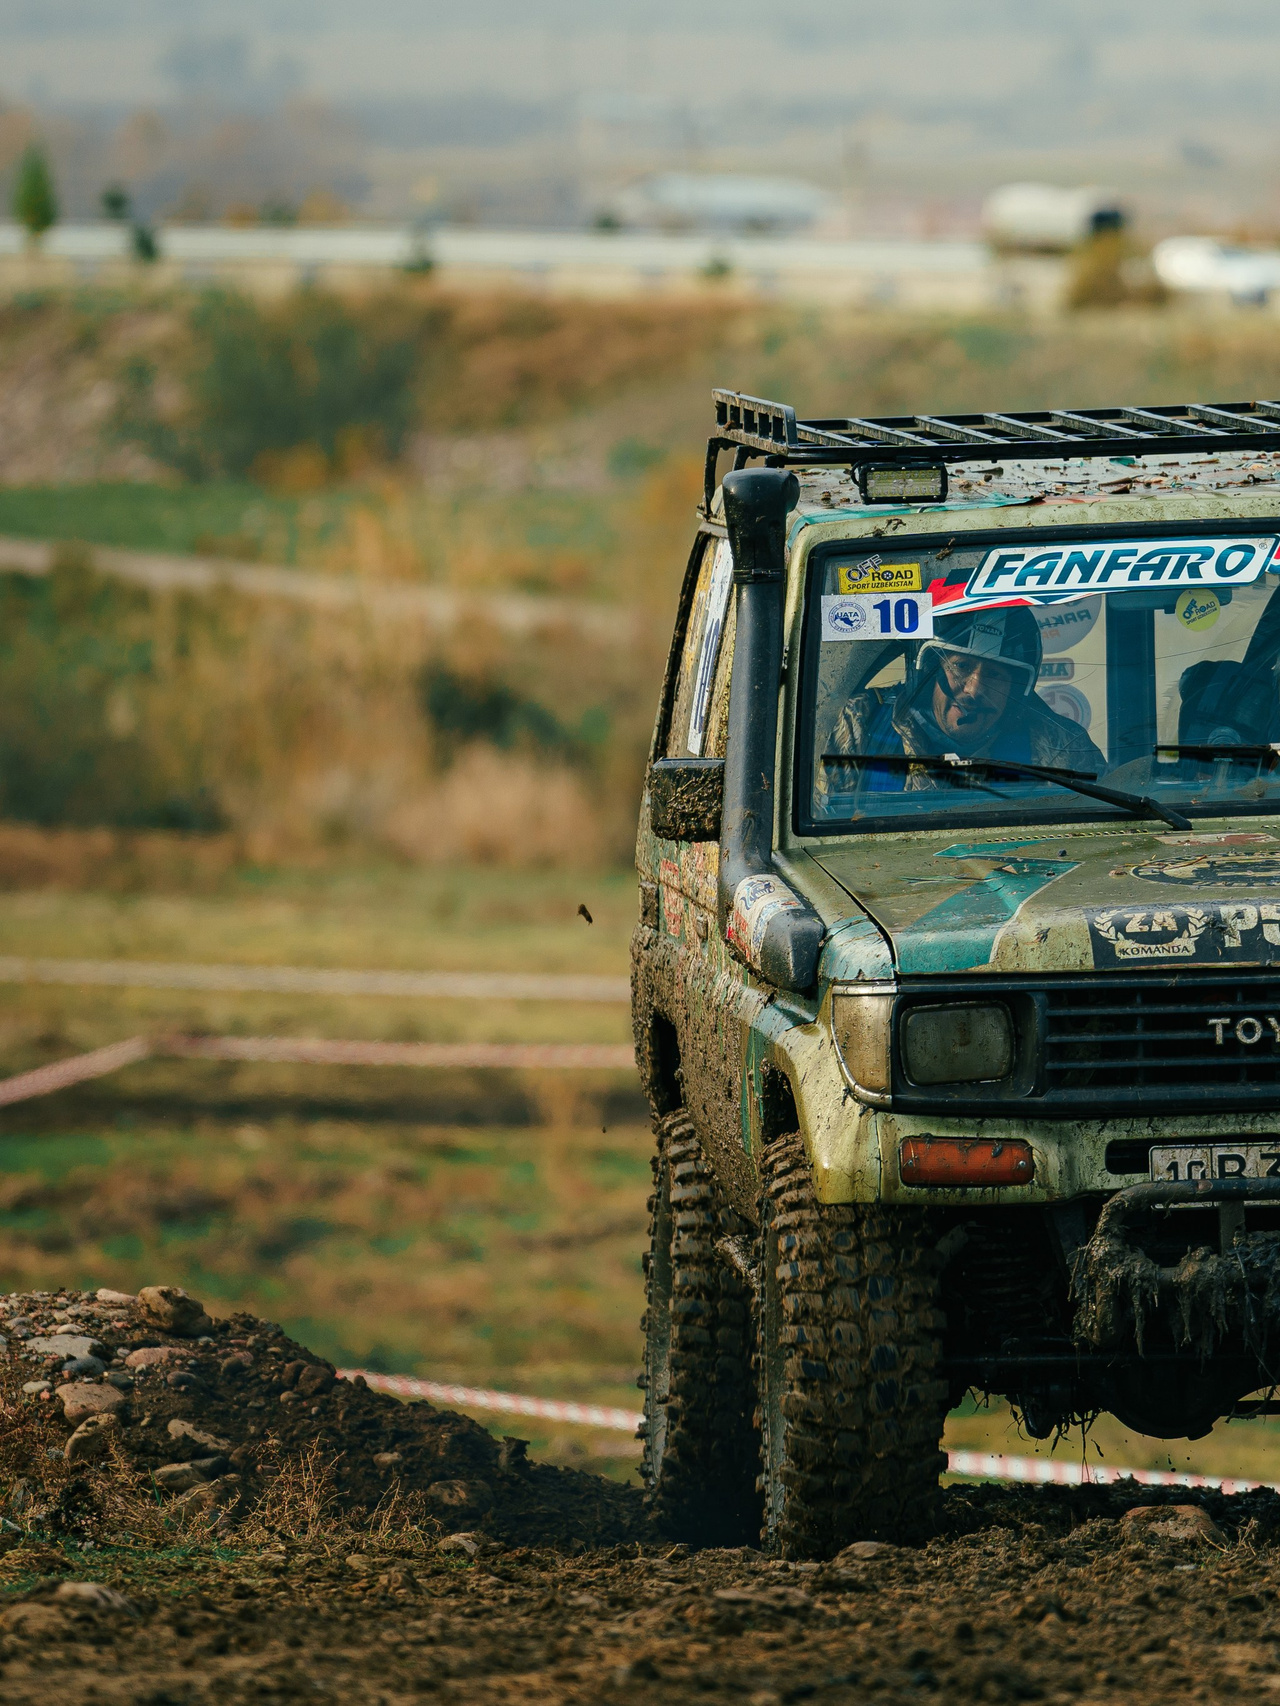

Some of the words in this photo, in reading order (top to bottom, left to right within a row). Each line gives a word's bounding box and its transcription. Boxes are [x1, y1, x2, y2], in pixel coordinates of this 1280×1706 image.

[846, 554, 882, 582] OFF
[871, 569, 914, 581] ROAD
[982, 544, 1257, 588] FANFARO
[847, 582, 869, 590] SPORT
[873, 598, 919, 633] 10
[1182, 598, 1198, 619] OFF
[1195, 601, 1216, 615] ROAD
[1186, 617, 1197, 625] SPORT
[1197, 607, 1218, 620] UZBEKISTAN
[1121, 945, 1190, 956] KOMANDA
